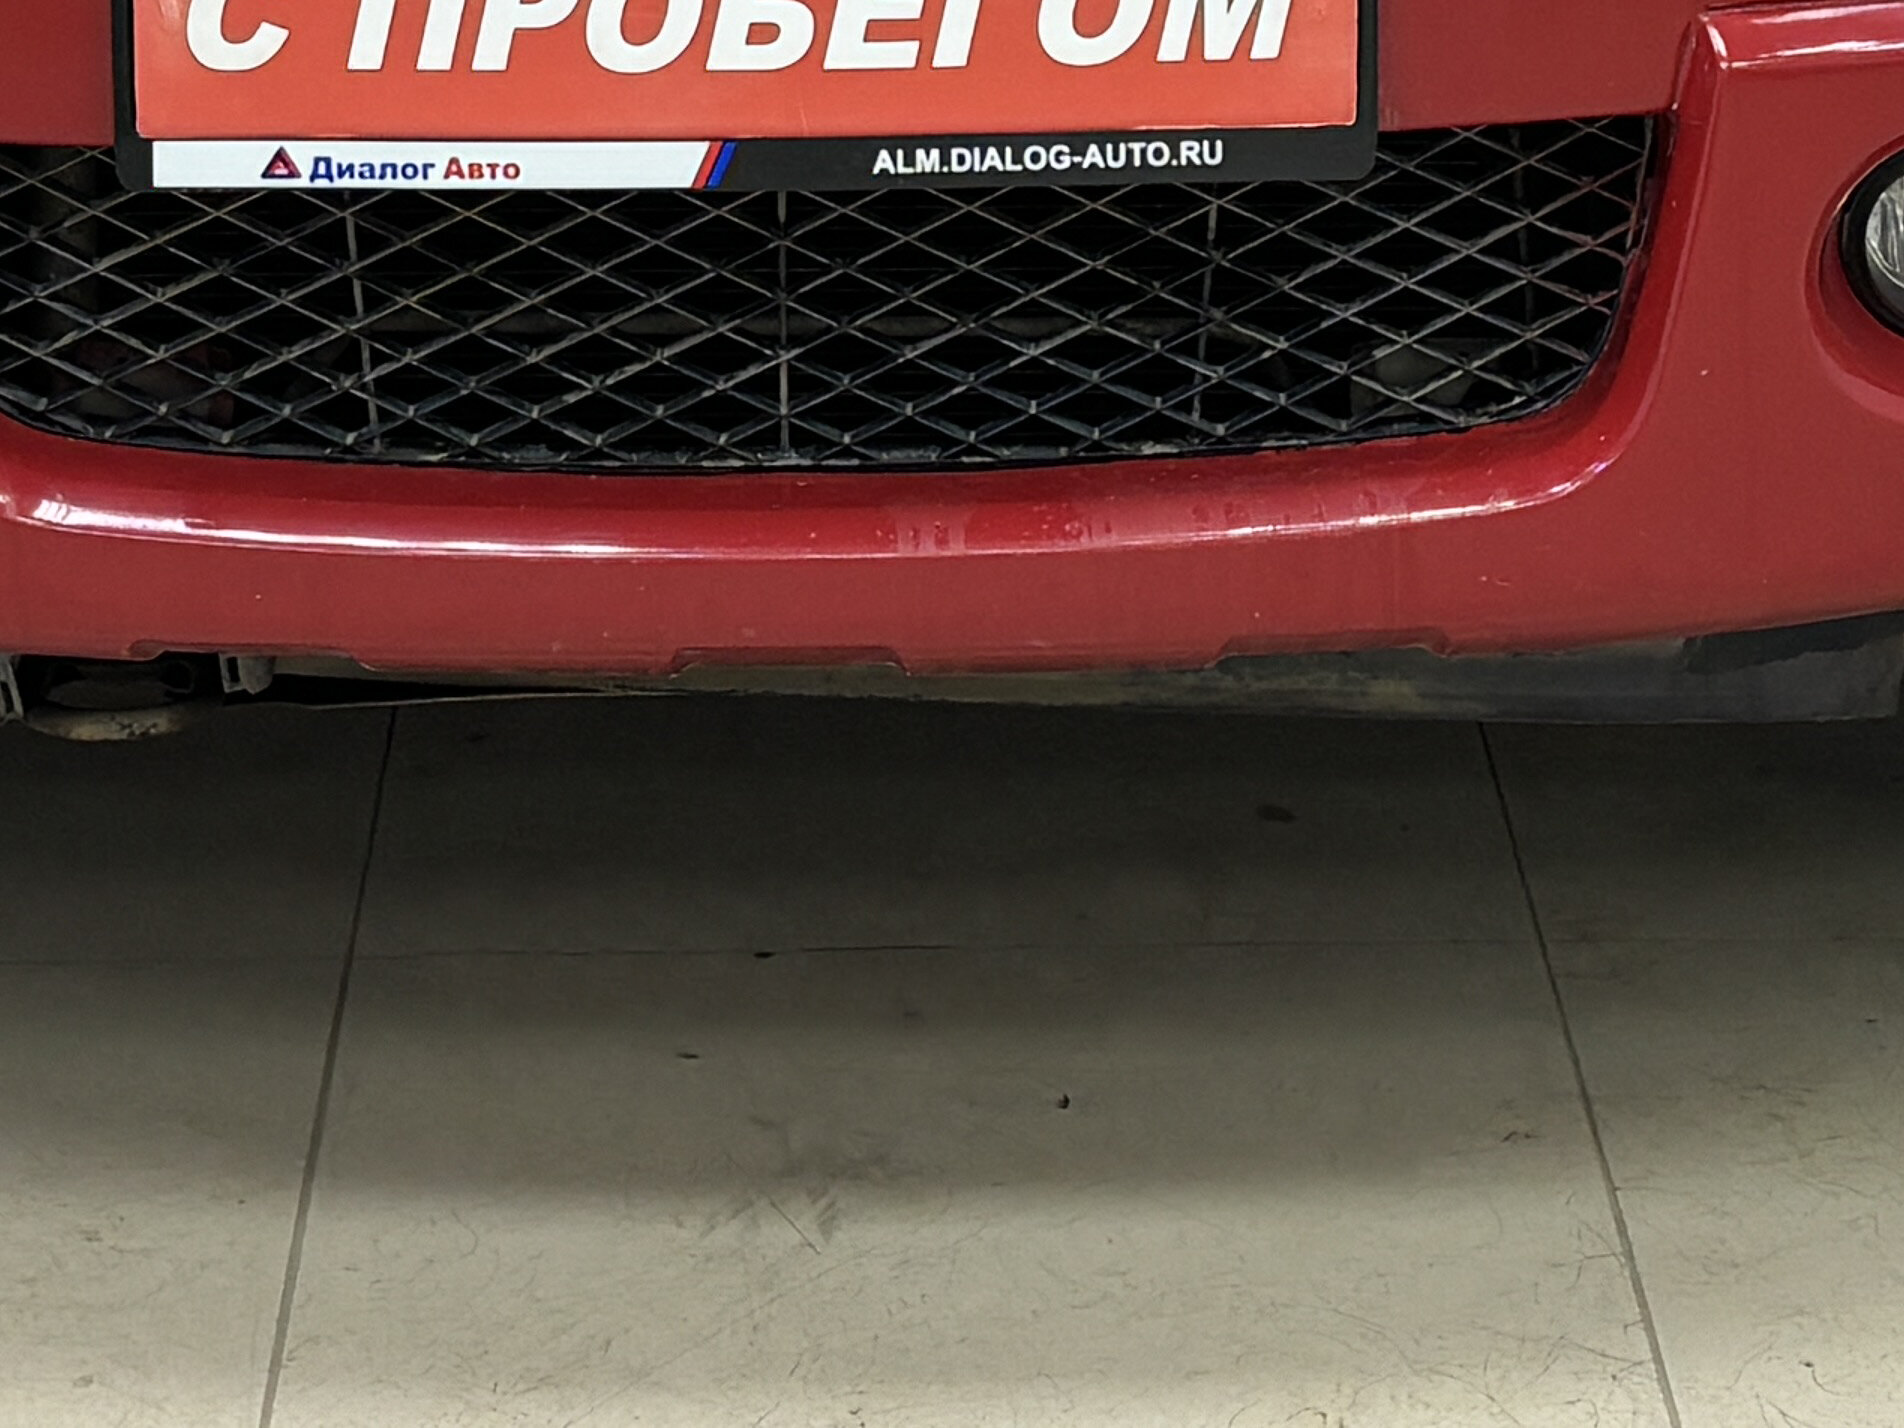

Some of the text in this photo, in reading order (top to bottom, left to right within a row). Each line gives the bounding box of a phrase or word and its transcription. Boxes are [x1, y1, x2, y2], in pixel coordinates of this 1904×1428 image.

[309, 156, 522, 184] Диалог Авто
[871, 139, 1224, 175] ALM.DIALOG-AUTO.RU
